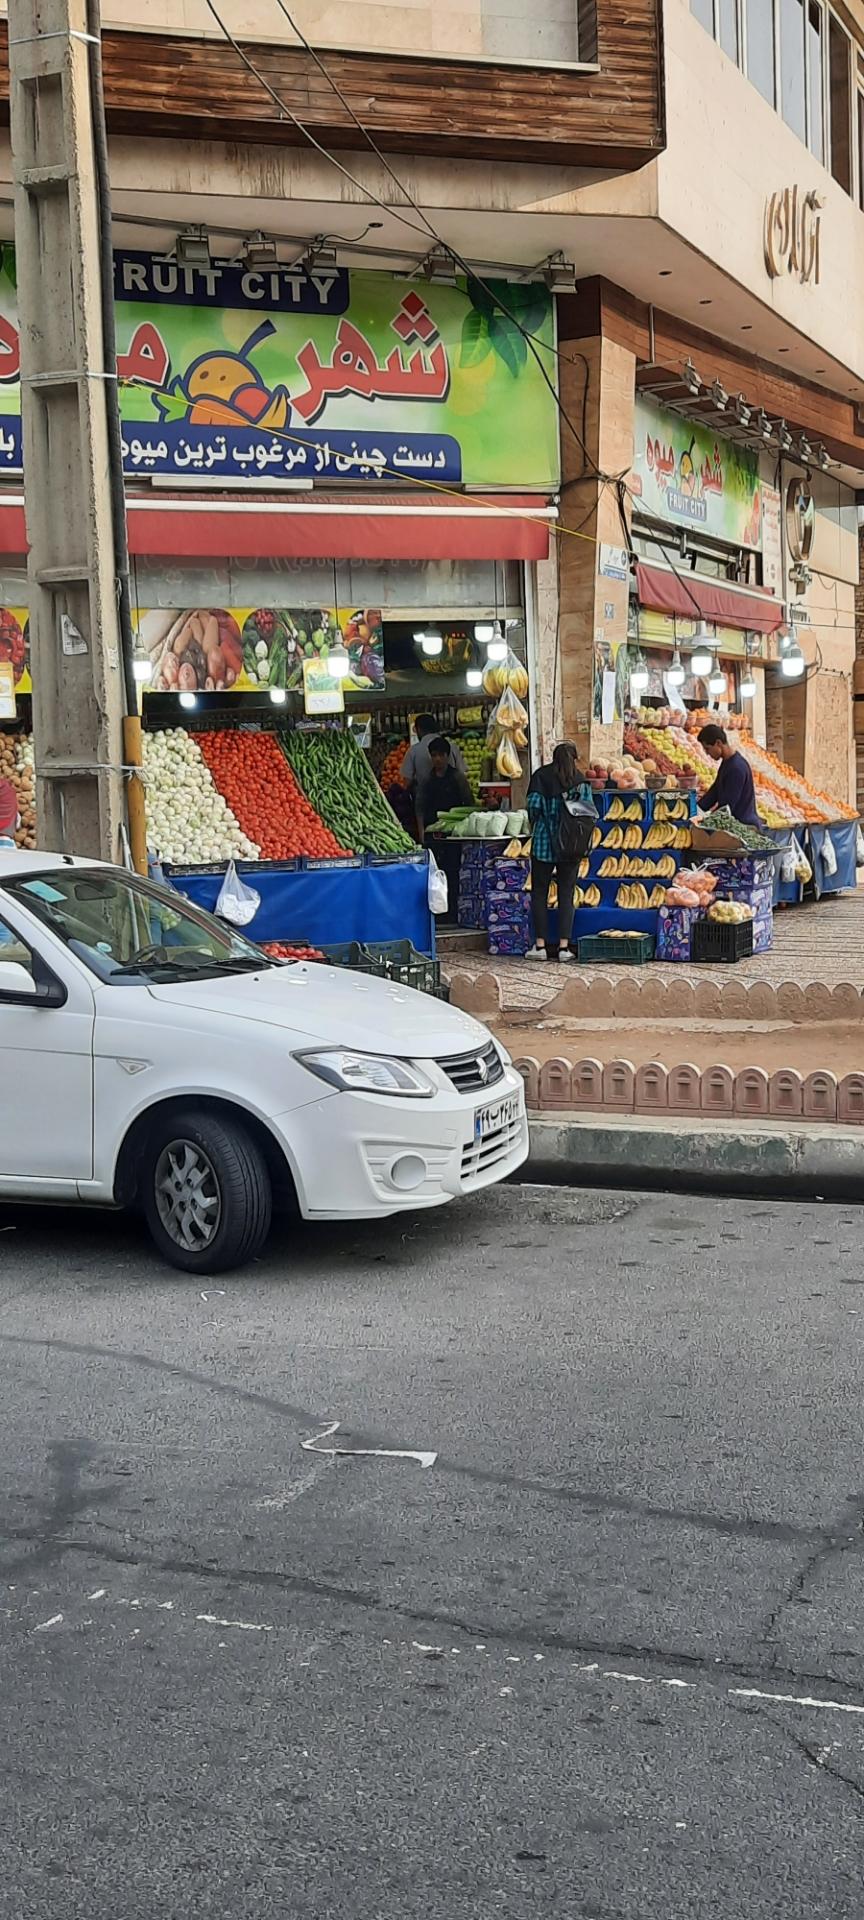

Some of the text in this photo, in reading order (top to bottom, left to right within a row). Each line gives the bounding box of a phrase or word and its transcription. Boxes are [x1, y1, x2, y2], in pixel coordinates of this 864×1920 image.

[112, 261, 336, 305] RUIT CITY
[288, 289, 451, 425] شهر
[173, 435, 227, 467] ترین
[232, 436, 308, 469] مرغوب
[314, 442, 331, 467] از
[336, 441, 388, 478] چینی
[392, 444, 447, 469] دست
[669, 491, 705, 518] FRUIT CITY
